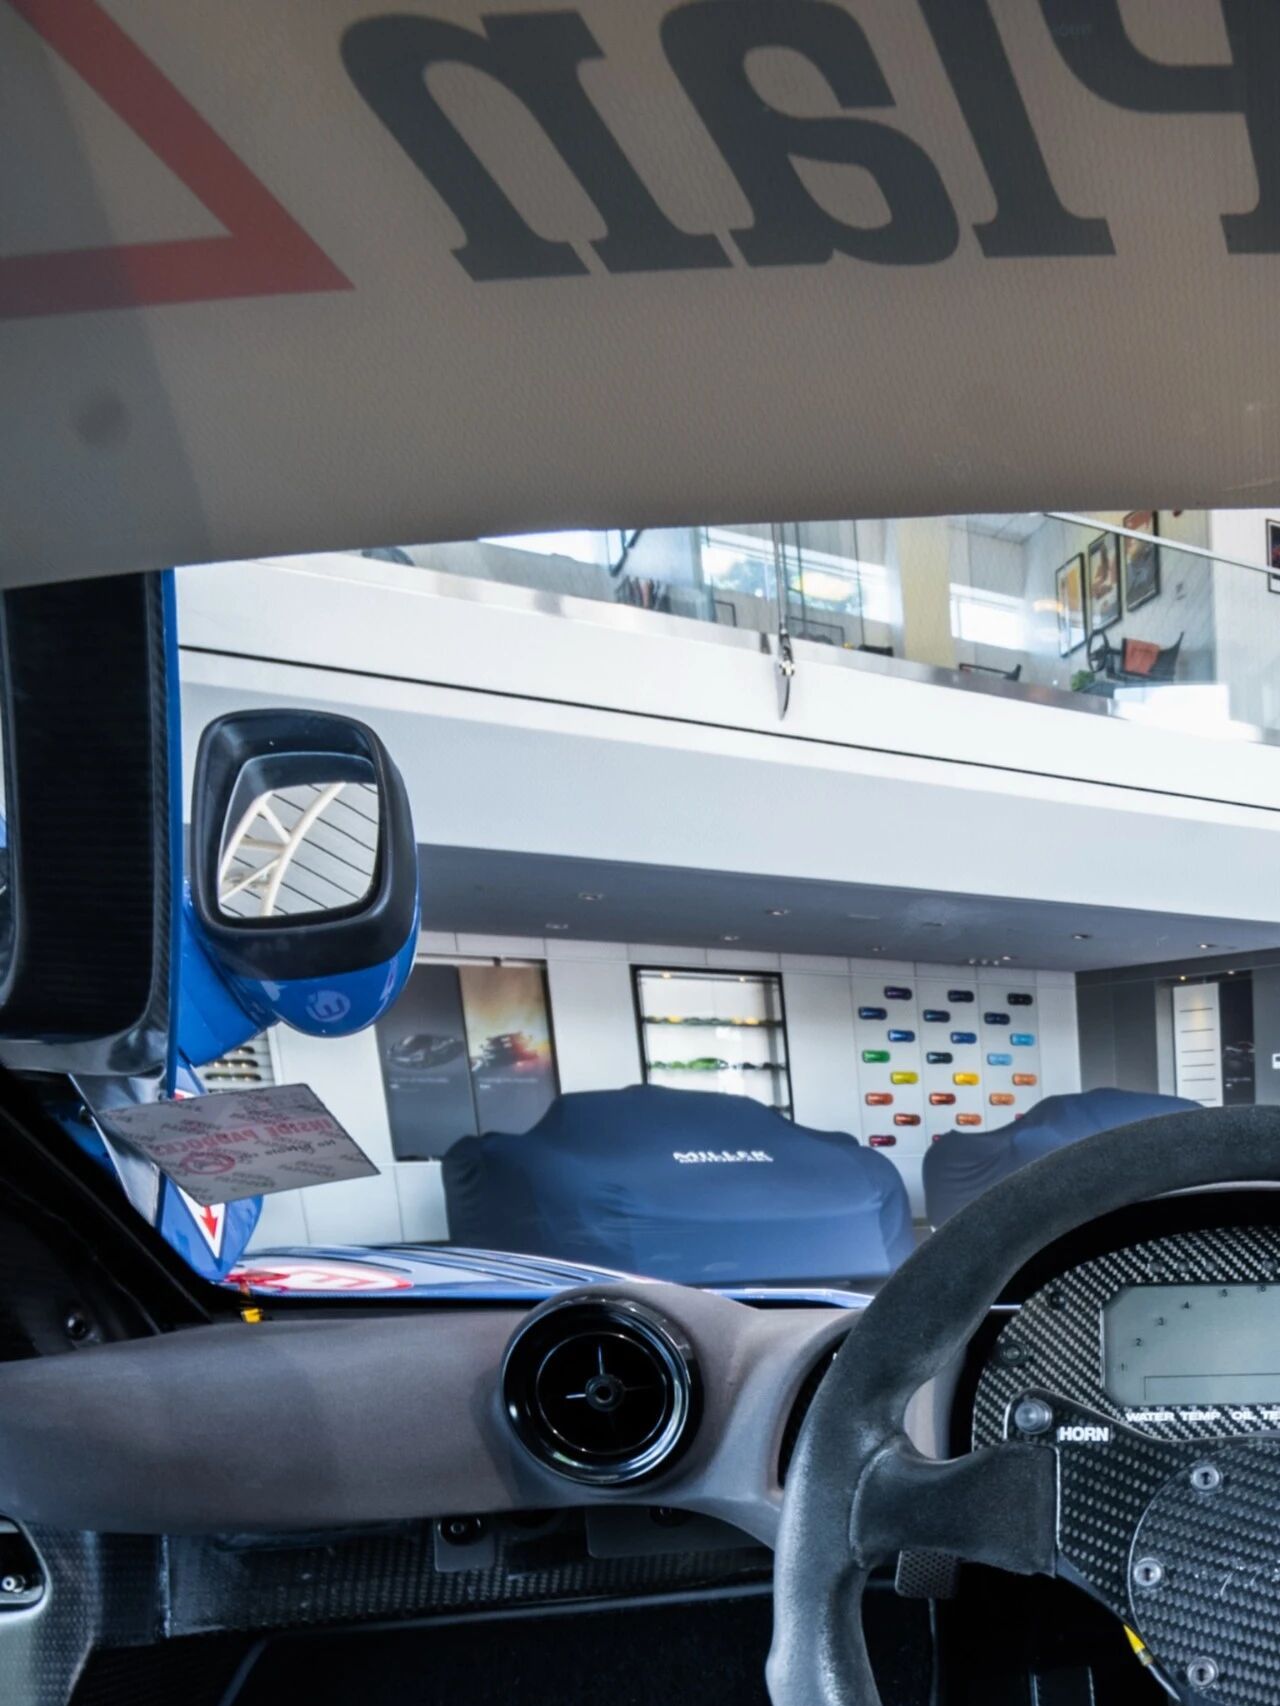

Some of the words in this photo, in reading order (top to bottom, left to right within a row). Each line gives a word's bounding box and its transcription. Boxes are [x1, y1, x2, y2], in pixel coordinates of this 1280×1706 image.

[1125, 1412, 1175, 1422] WATER
[1180, 1411, 1221, 1421] TEMP
[1231, 1411, 1256, 1421] OIL
[1059, 1426, 1109, 1442] HORN
